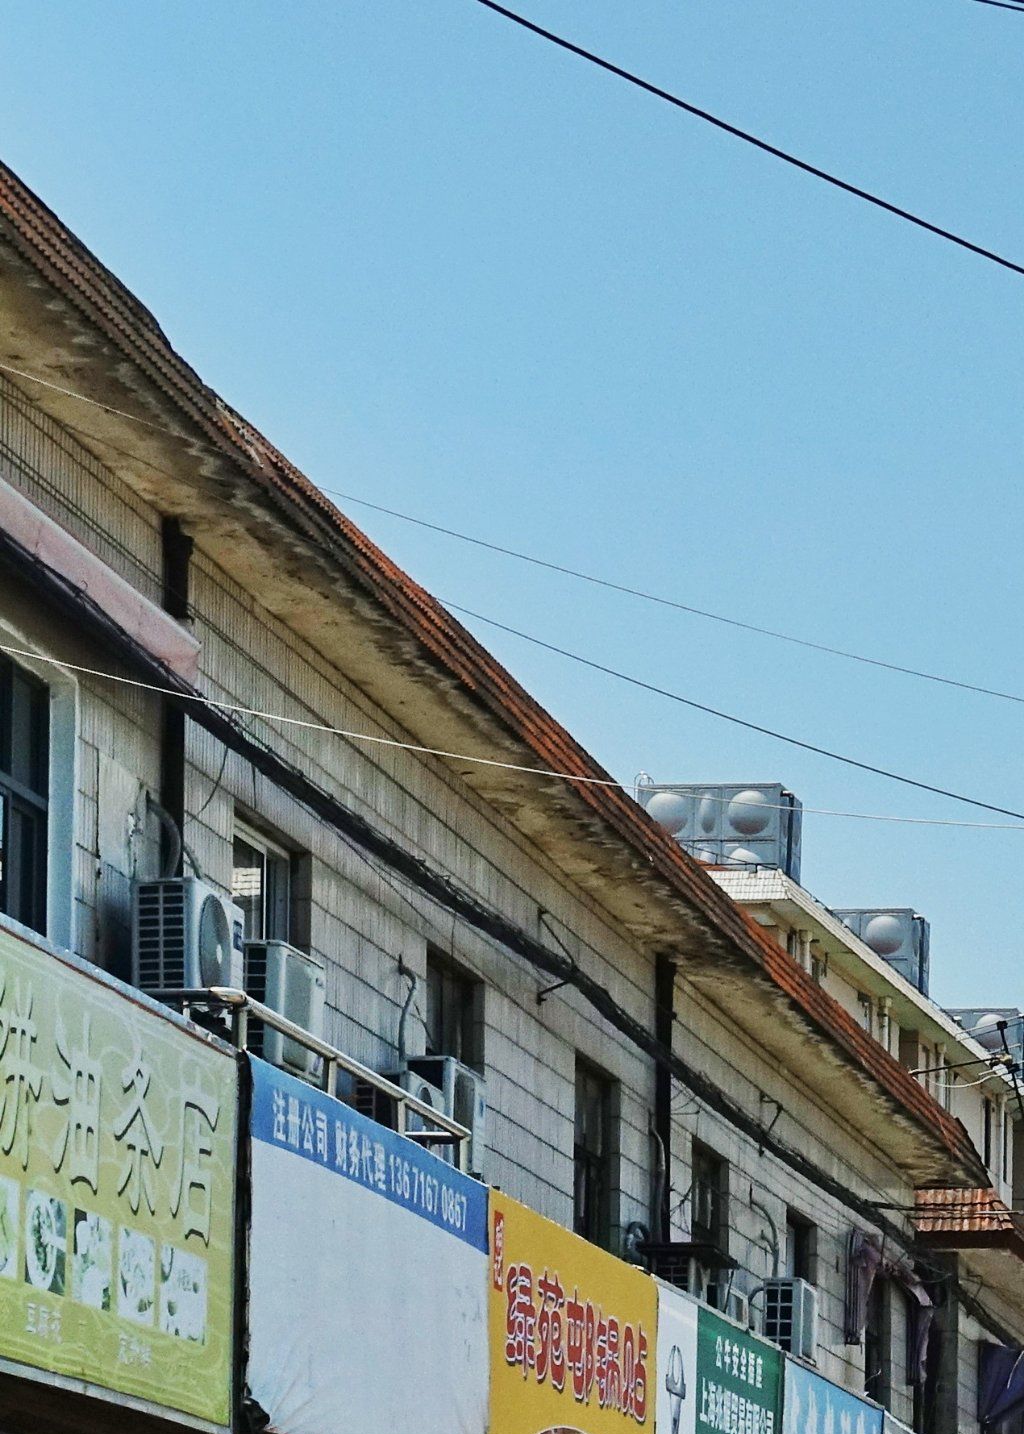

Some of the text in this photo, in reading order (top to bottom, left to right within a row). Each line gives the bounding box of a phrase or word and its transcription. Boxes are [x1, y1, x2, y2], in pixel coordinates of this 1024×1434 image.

[273, 1088, 328, 1162] 注册公司
[334, 1120, 386, 1191] 财务代理
